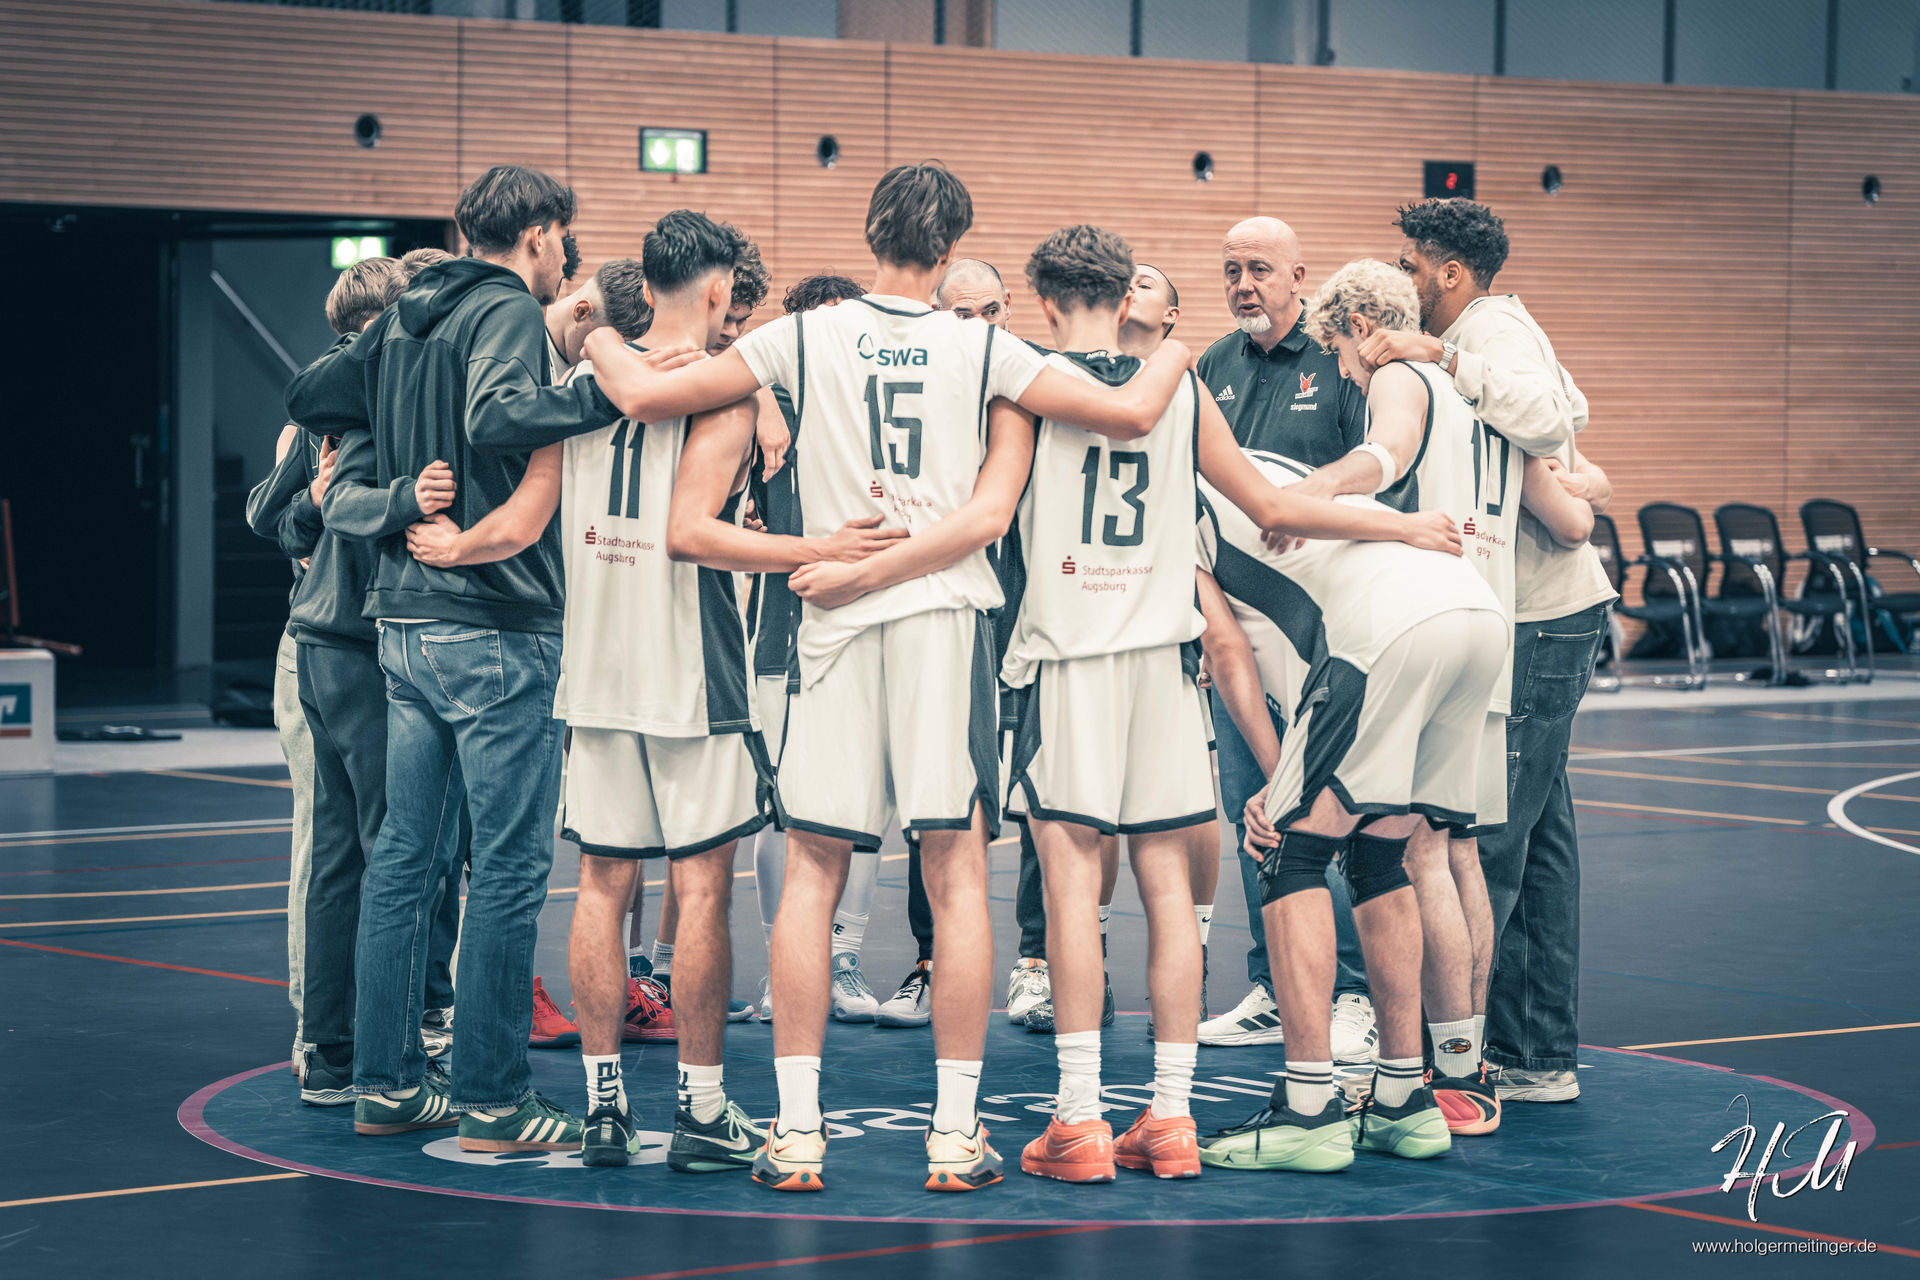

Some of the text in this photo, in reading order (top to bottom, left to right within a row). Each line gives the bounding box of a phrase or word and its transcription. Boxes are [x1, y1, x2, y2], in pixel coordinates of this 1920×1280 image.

[877, 347, 928, 367] swa
[608, 419, 646, 520] 11
[864, 374, 924, 479] 15
[1081, 445, 1150, 547] 13
[1082, 581, 1127, 593] Augsburg
